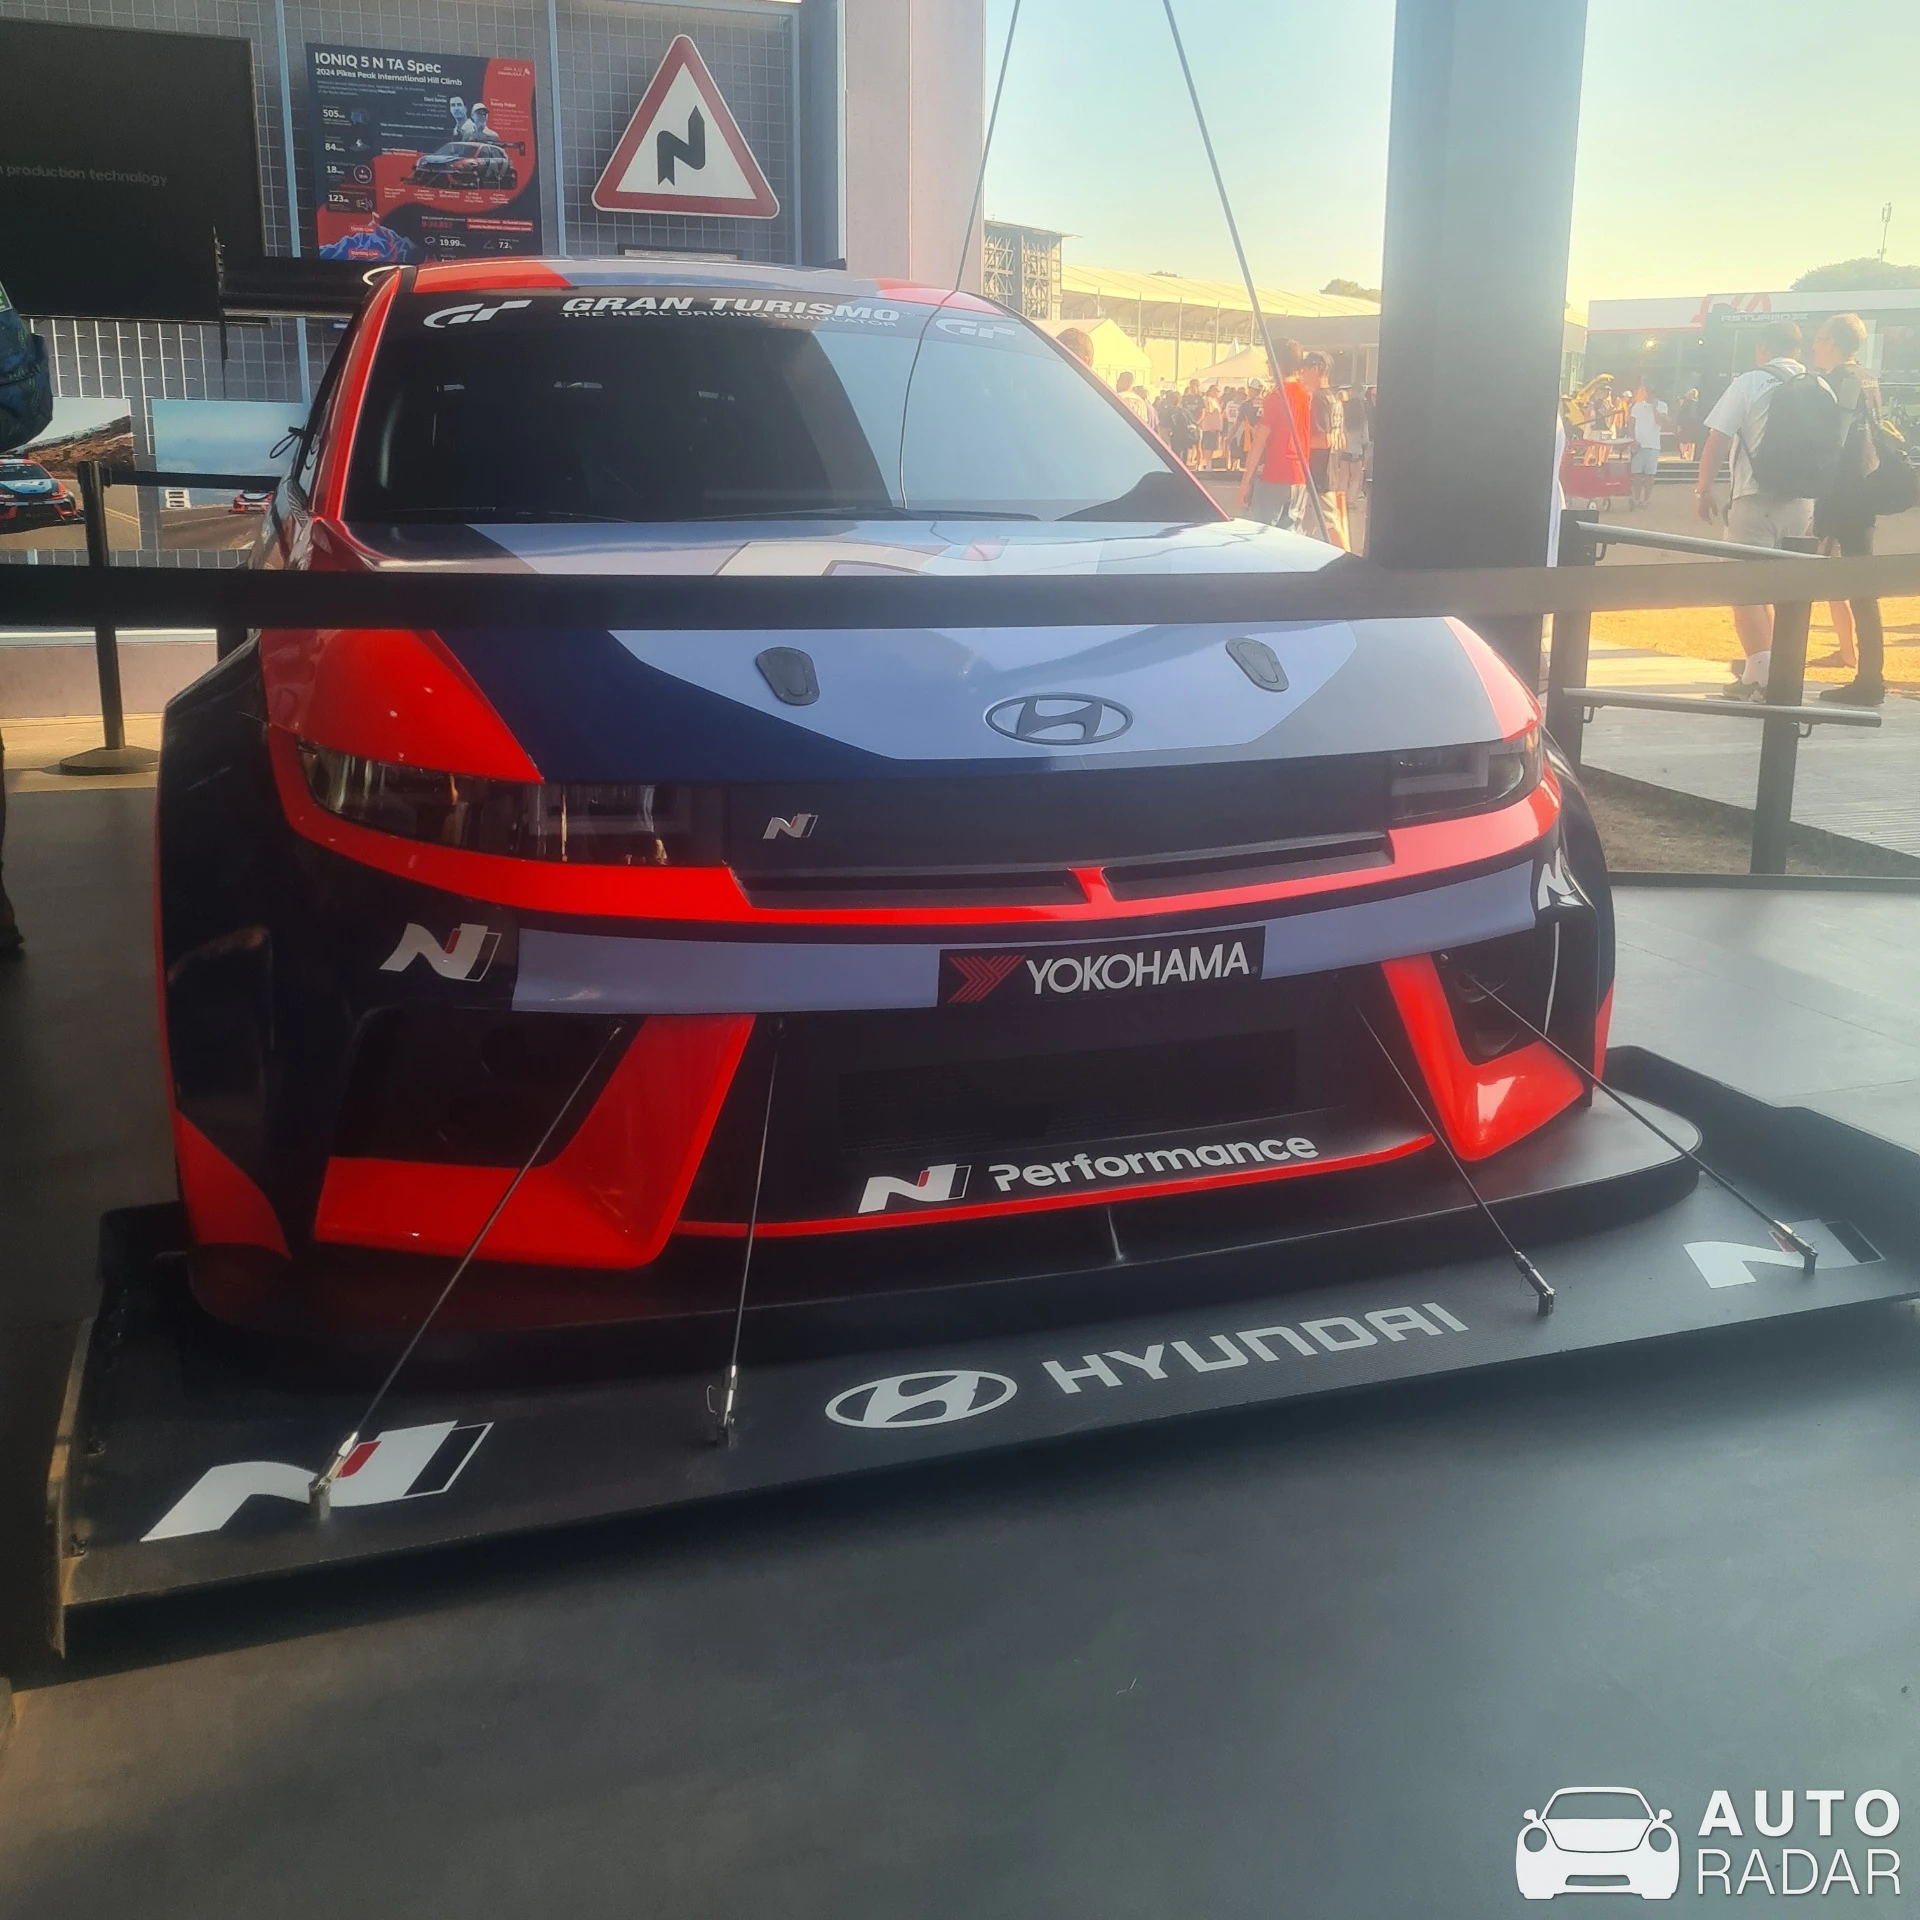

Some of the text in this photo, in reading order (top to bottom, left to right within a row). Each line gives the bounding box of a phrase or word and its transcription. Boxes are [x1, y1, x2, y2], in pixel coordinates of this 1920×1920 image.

[315, 52, 442, 74] IONIQ 5 N TA Spec
[316, 68, 462, 86] 2024 Pikes Peak International Hill Climb
[7, 165, 85, 179] production
[90, 168, 167, 186] technology
[562, 297, 899, 321] GRAN TURISMO
[678, 310, 768, 318] DRIVING
[774, 313, 897, 328] SIMULATOR
[1025, 941, 1250, 995] YOKOHAMA
[988, 1136, 1319, 1192] Performance
[1041, 1301, 1469, 1394] HYUNDAI
